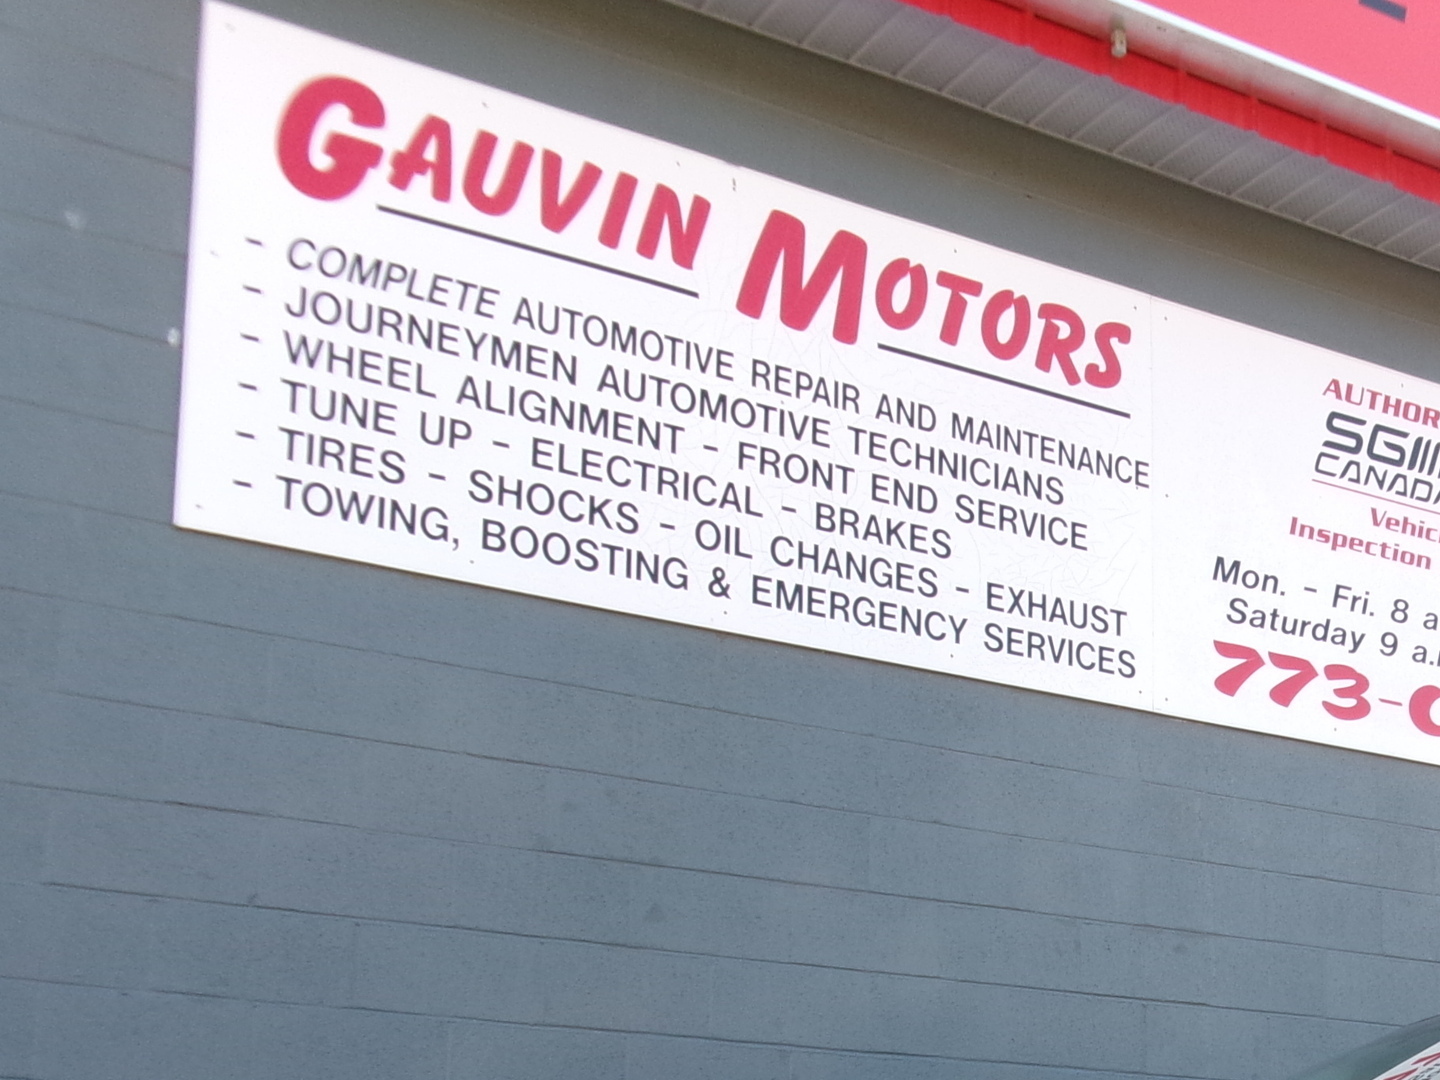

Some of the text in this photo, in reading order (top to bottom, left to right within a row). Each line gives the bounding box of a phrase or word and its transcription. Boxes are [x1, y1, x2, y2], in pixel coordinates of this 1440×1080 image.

[275, 75, 1132, 389] GAUVIN MOTORS
[284, 330, 437, 399] WHEEL
[456, 375, 685, 454] ALIGNMENT
[738, 441, 855, 495] FRONT
[871, 473, 938, 514] END
[954, 493, 1088, 551] SERVICE
[285, 287, 577, 386] JOURNEYMEN
[596, 364, 831, 449] AUTOMOTIVE
[847, 425, 1064, 506] TECHNICIANS
[288, 238, 500, 319] COMPLETE
[512, 297, 734, 382] AUTOMOTIVE
[751, 358, 860, 414] REPAIR
[875, 393, 937, 432] AND
[951, 412, 1150, 489] MAINTENANCE
[278, 426, 406, 485] TIRES
[468, 469, 639, 535] SHOCKS
[694, 519, 753, 560] OIL
[770, 535, 938, 598] CHANGES
[986, 581, 1128, 637] EXHAUST
[281, 378, 398, 436] TUNE
[420, 411, 472, 449] UP
[531, 436, 763, 518] ELECTRICAL
[815, 501, 952, 559] BRAKES
[1288, 516, 1432, 570] Inspection
[276, 475, 459, 551] TOWING,
[481, 518, 688, 591] BOOSTING
[707, 566, 731, 599] &
[752, 574, 968, 644] EMERGENCY
[983, 622, 1136, 679] SERVICES
[1212, 555, 1286, 596] Mon.
[1332, 584, 1374, 617] Fri.
[1390, 598, 1409, 624] 8
[1226, 597, 1366, 654] Saturday
[1379, 631, 1398, 657] 9
